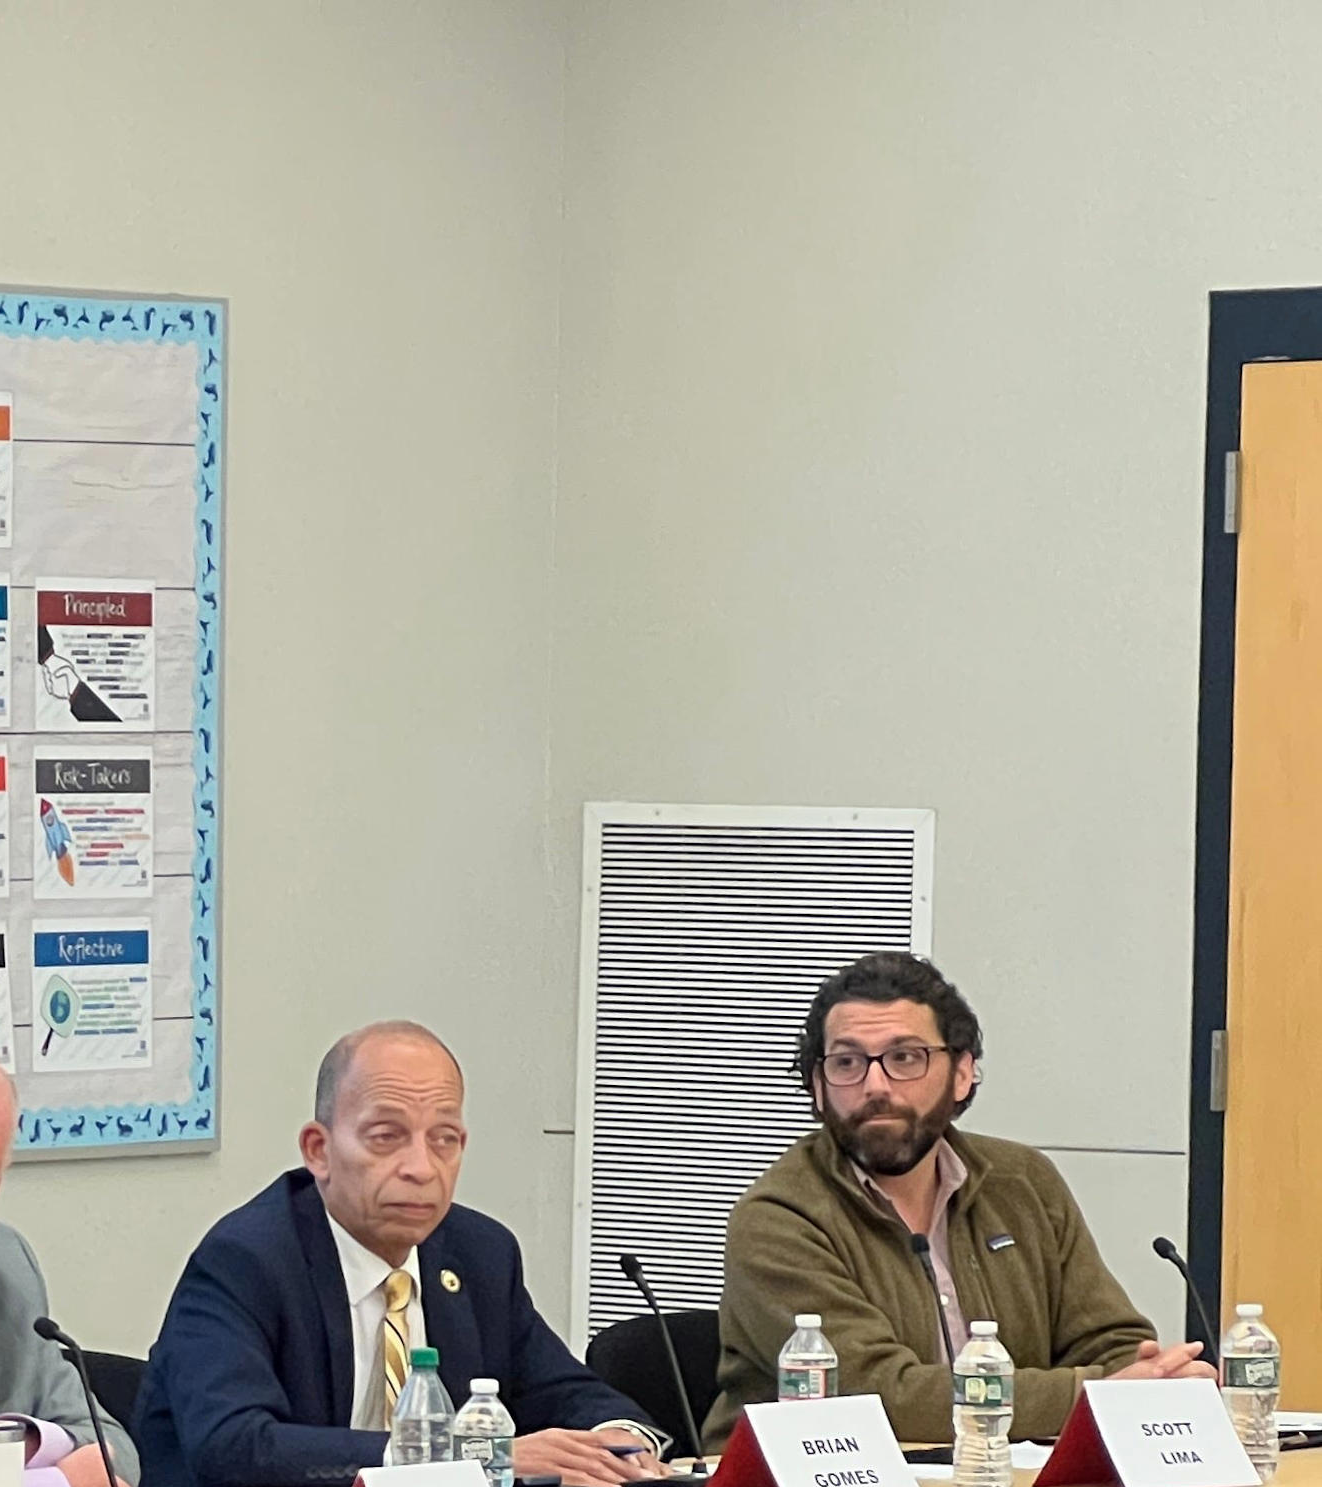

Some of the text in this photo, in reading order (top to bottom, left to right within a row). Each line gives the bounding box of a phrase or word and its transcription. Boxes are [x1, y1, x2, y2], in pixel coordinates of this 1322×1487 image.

[64, 593, 126, 623] Principled
[55, 762, 131, 789] Risk-Takers
[59, 935, 124, 962] Reflective
[1141, 1422, 1192, 1438] SCOTT
[802, 1437, 859, 1457] BRIAN
[1161, 1449, 1203, 1465] LIMA
[814, 1468, 879, 1487] GOMES
